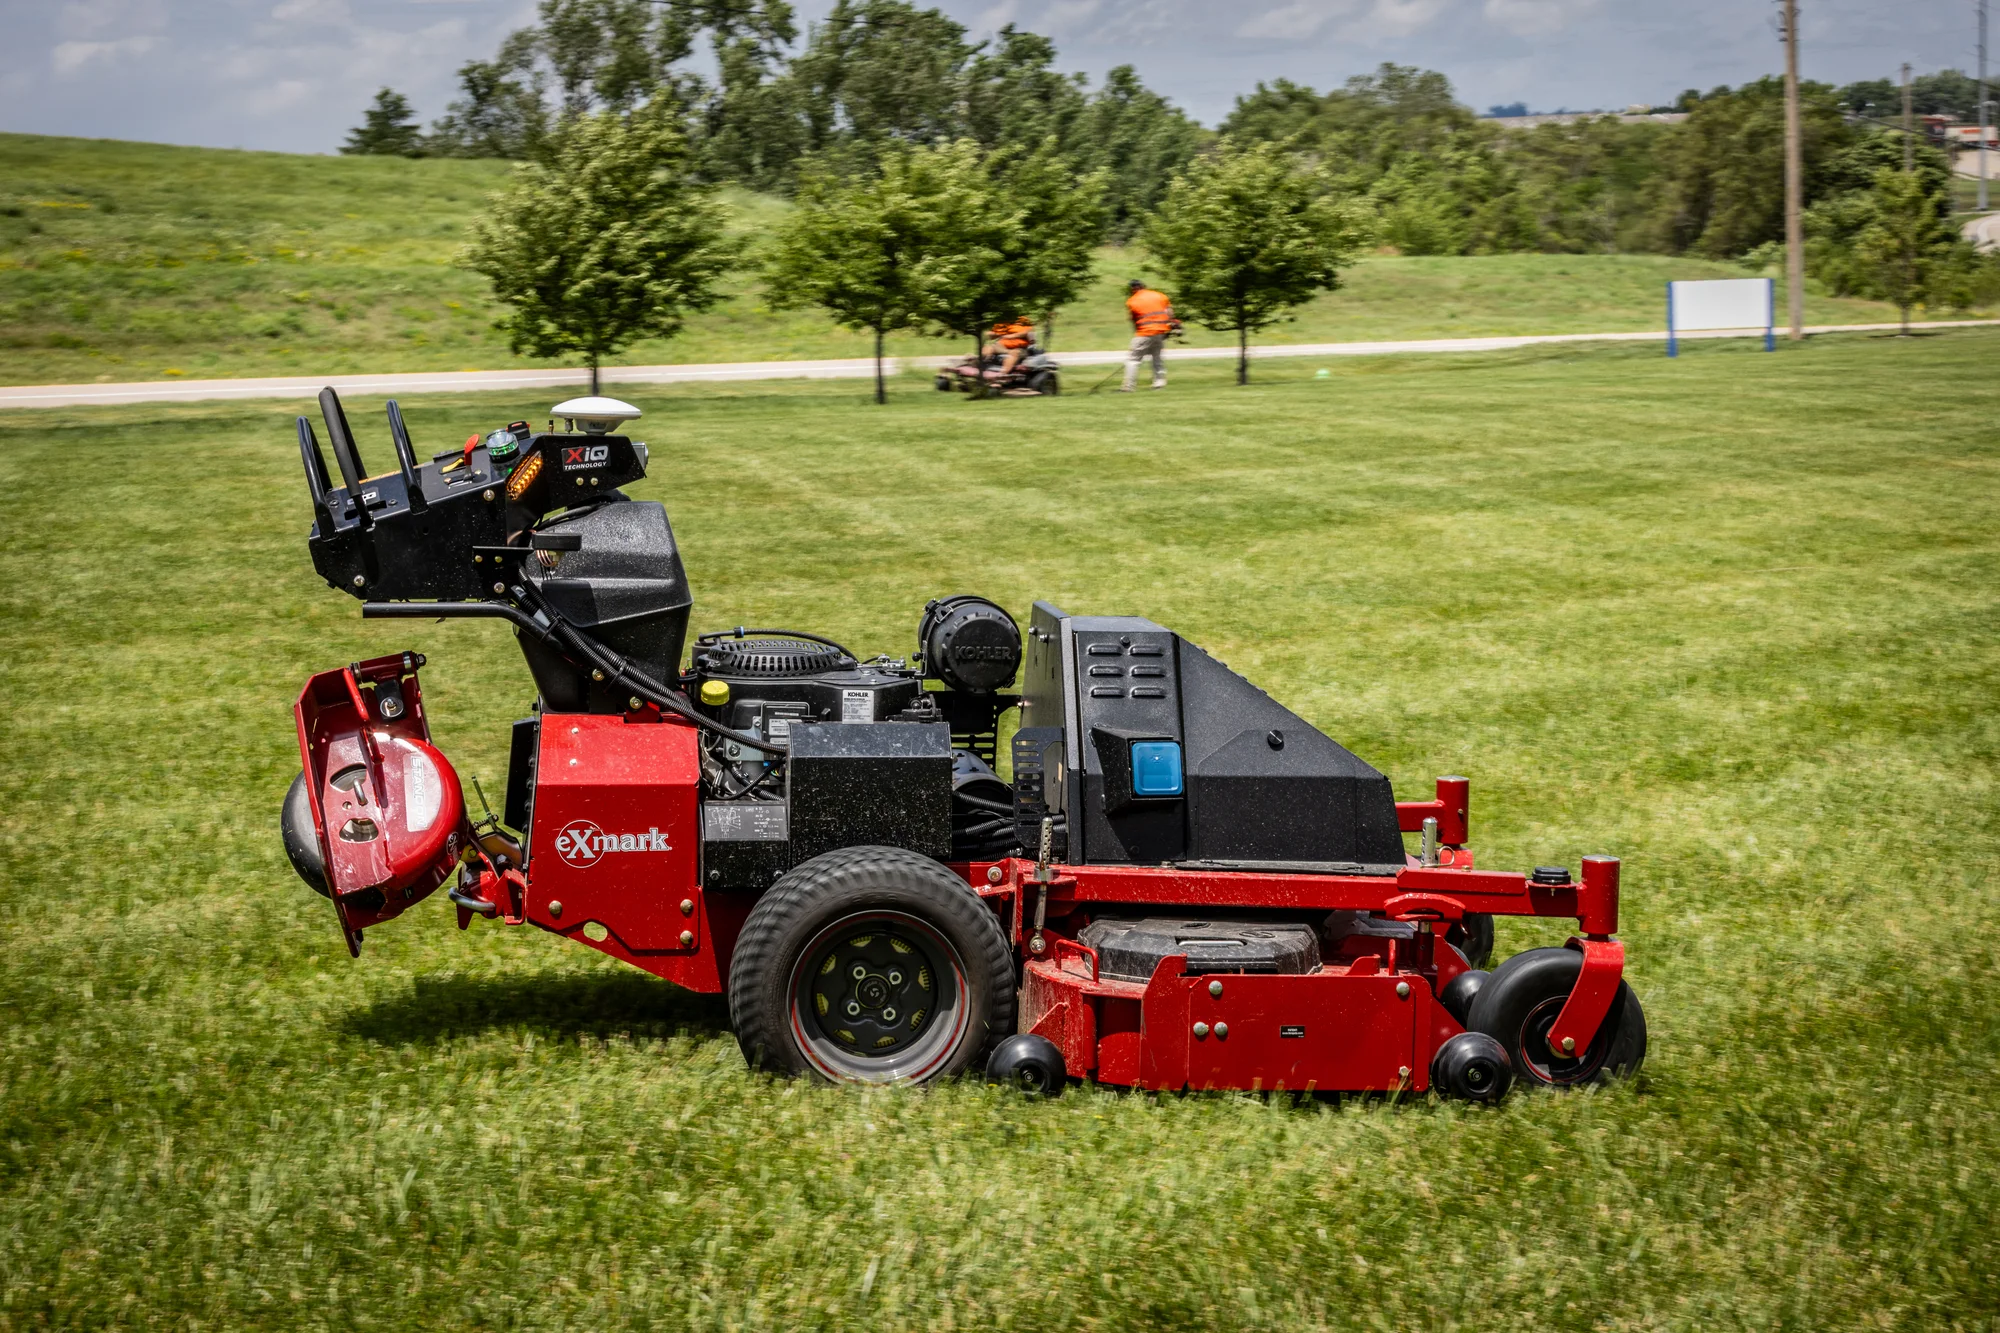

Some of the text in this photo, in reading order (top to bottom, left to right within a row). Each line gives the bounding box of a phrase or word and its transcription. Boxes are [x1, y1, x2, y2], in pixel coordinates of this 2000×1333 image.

[565, 446, 609, 464] XiQ
[564, 461, 607, 471] TECHNOLOGY
[955, 645, 1013, 660] KOHLER
[555, 828, 671, 859] eXmark
